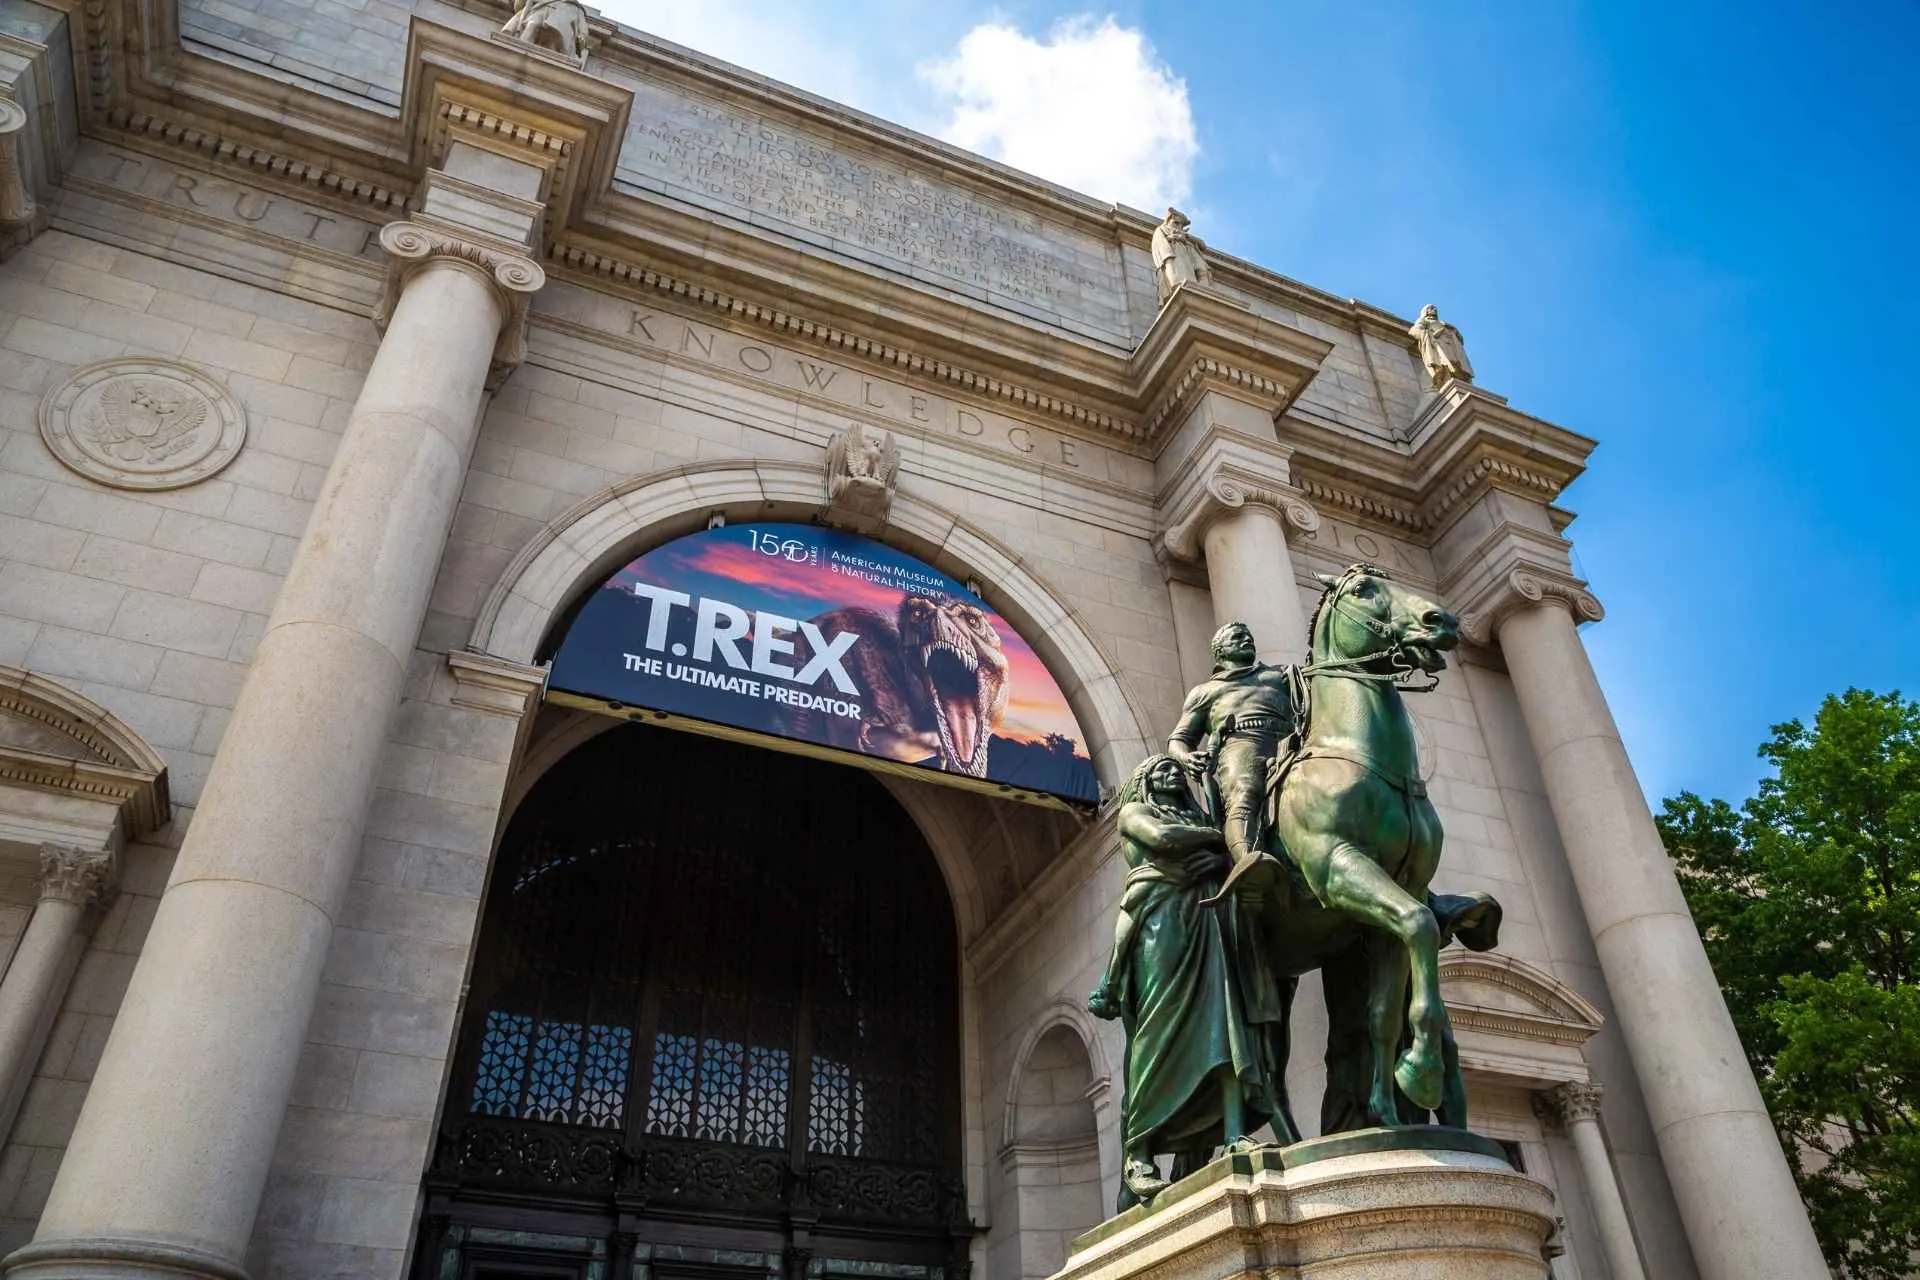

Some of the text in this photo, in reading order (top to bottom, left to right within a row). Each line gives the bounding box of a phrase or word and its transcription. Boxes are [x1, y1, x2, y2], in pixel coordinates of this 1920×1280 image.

[638, 124, 705, 155] ENERGY
[712, 149, 750, 170] AND
[755, 164, 848, 204] FORTITUDE
[857, 199, 875, 212] IN
[879, 207, 913, 226] THE
[968, 238, 988, 252] OF
[993, 247, 1028, 266] OUR
[648, 149, 668, 164] IN
[678, 160, 713, 179] THE
[722, 175, 770, 199] LOVE
[777, 193, 817, 215] AND
[824, 209, 962, 265] CONSERVATION
[968, 259, 992, 275] OF
[658, 119, 1059, 267] A GREAT LEADER OF THE YOUTH OF AMERICA
[667, 145, 687, 159] IN
[696, 155, 775, 190] DEFENSE
[780, 183, 804, 200] OF
[812, 194, 847, 214] THE
[853, 208, 919, 239] RIGHTS
[924, 233, 946, 248] OF
[951, 242, 984, 261] THE
[687, 104, 1036, 235] STATE OF NEW YORK MEMORIAL TO
[729, 130, 996, 233] THEODORE ROOSEVELT
[680, 173, 1035, 301] AND OF THE BEST IN LIFE AND IN MAN
[625, 312, 1079, 467] KNOWLEDGE
[810, 545, 818, 566] YEARS
[831, 551, 944, 588] AMERICAN MUSEUM
[841, 566, 894, 587] NATURAL
[896, 581, 943, 598] HISTORY
[623, 653, 862, 720] THE ULTIMATE PREDATOR
[634, 582, 860, 697] T.REX
